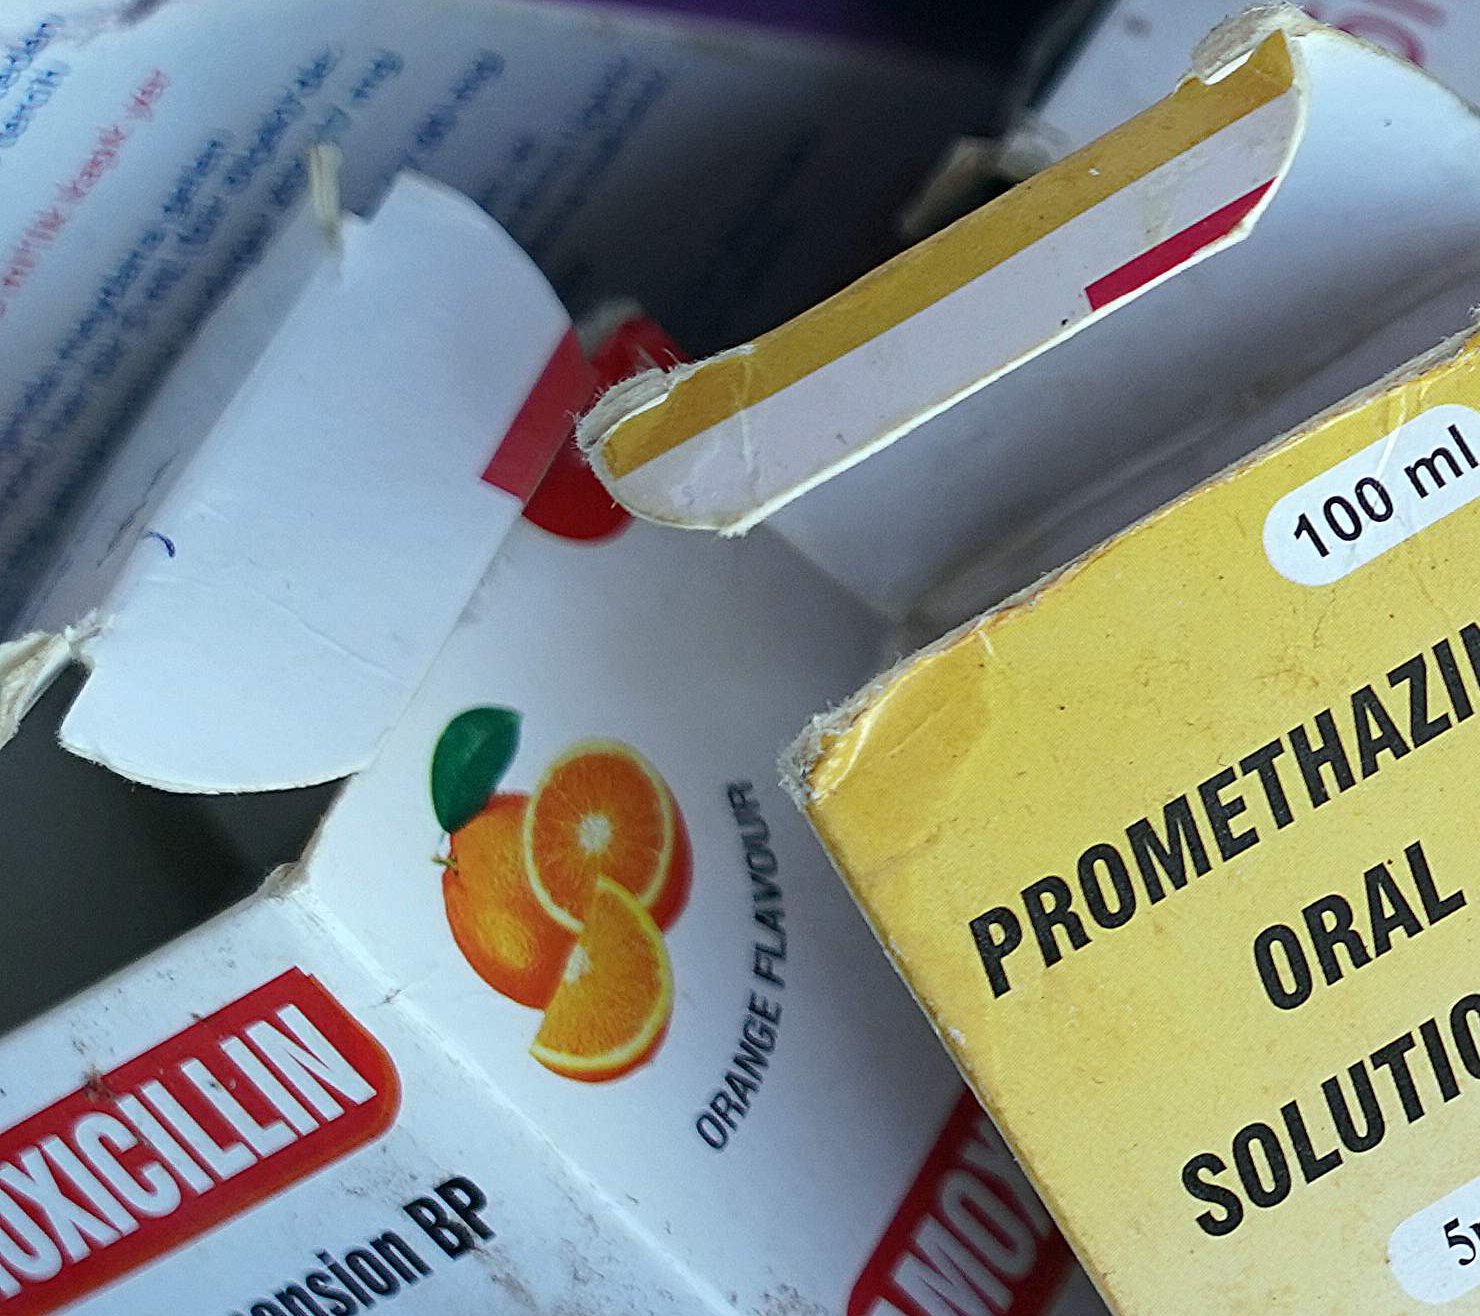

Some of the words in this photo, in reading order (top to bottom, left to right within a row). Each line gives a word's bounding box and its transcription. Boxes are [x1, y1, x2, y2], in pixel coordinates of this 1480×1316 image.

[1293, 476, 1394, 558] 100
[1403, 424, 1480, 499] ml
[719, 776, 792, 989] FLAVOUR
[1250, 840, 1467, 1013] ORAL
[0, 1003, 378, 1291] OXICILLIN
[694, 992, 787, 1155] ORANGE
[401, 1174, 492, 1260] BP
